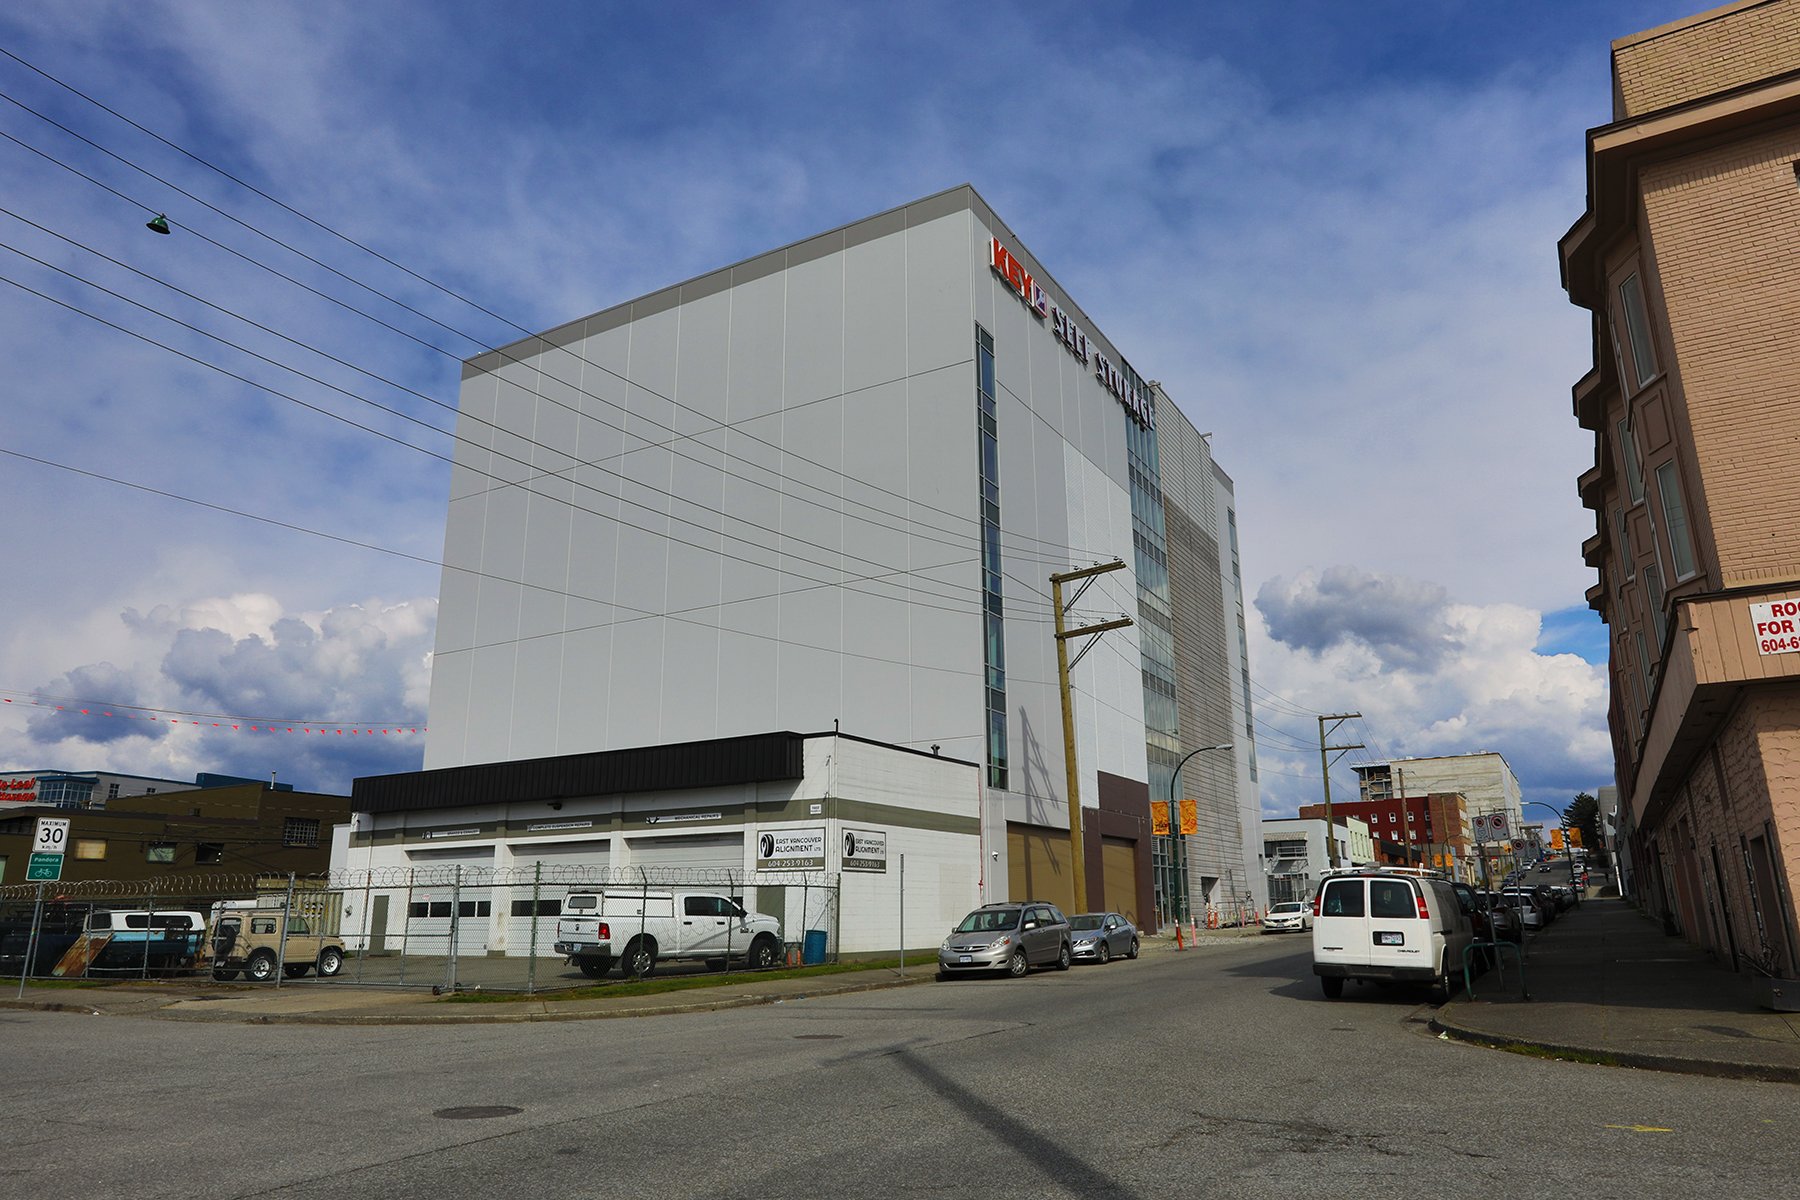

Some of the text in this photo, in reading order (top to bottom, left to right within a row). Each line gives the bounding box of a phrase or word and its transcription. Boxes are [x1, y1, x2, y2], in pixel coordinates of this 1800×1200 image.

[990, 236, 1035, 308] KEY
[1051, 304, 1156, 432] SELF STORAGE
[1771, 601, 1800, 617] RO
[1757, 619, 1795, 636] FOR
[1761, 636, 1800, 653] 604-6
[40, 828, 63, 843] 30
